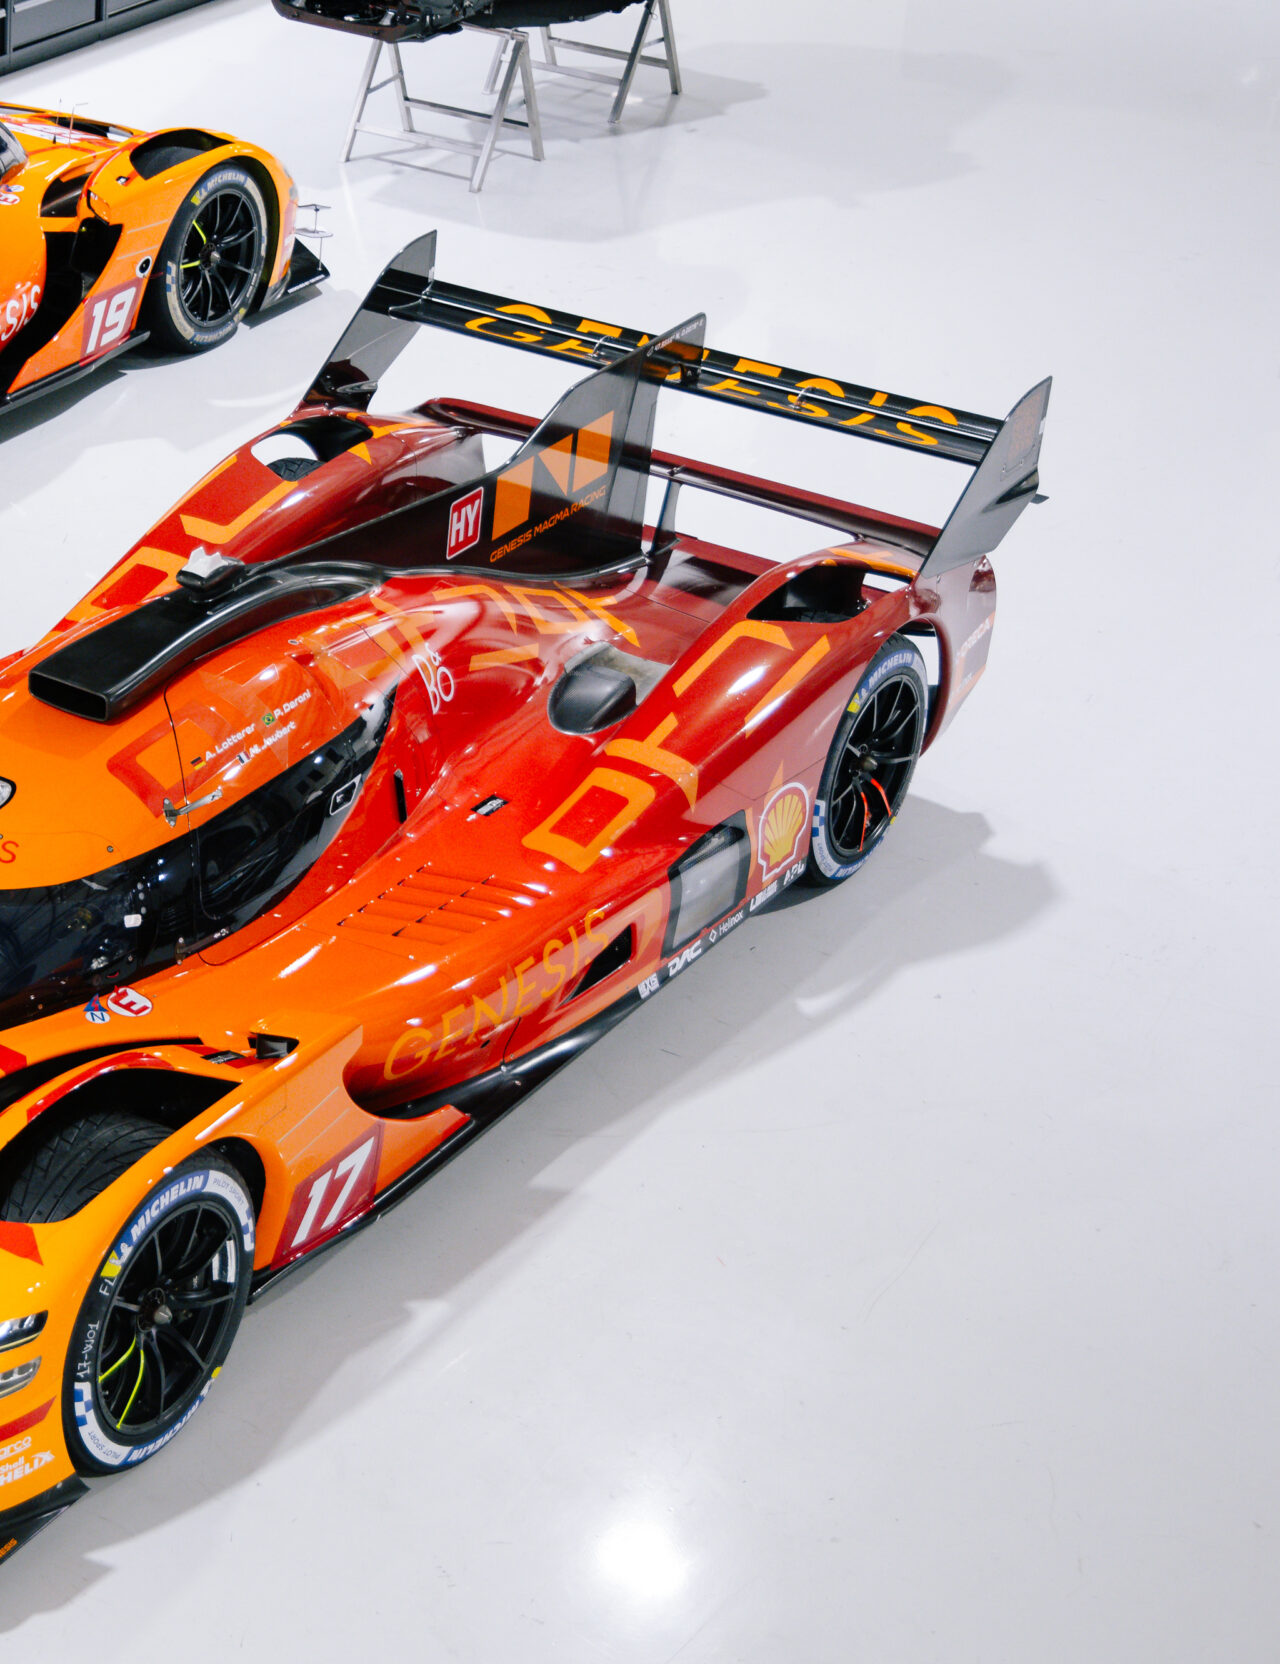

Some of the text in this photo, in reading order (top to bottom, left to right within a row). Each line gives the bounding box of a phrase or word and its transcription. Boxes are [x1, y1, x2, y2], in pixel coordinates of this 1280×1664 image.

[207, 171, 245, 191] MICHELIN
[86, 286, 136, 354] 19
[450, 499, 480, 547] HY
[490, 485, 607, 563] GENESIS MAGMA RACING
[869, 652, 912, 687] MICHELIN
[216, 723, 256, 755] Lotterer
[668, 939, 702, 977] DAC
[719, 910, 744, 936] Helinox
[383, 908, 609, 1081] GENESIS
[131, 1173, 205, 1243] MICHELIN
[212, 1177, 228, 1190] PILOT
[290, 1136, 374, 1247] 17
[0, 1455, 24, 1473] Shell
